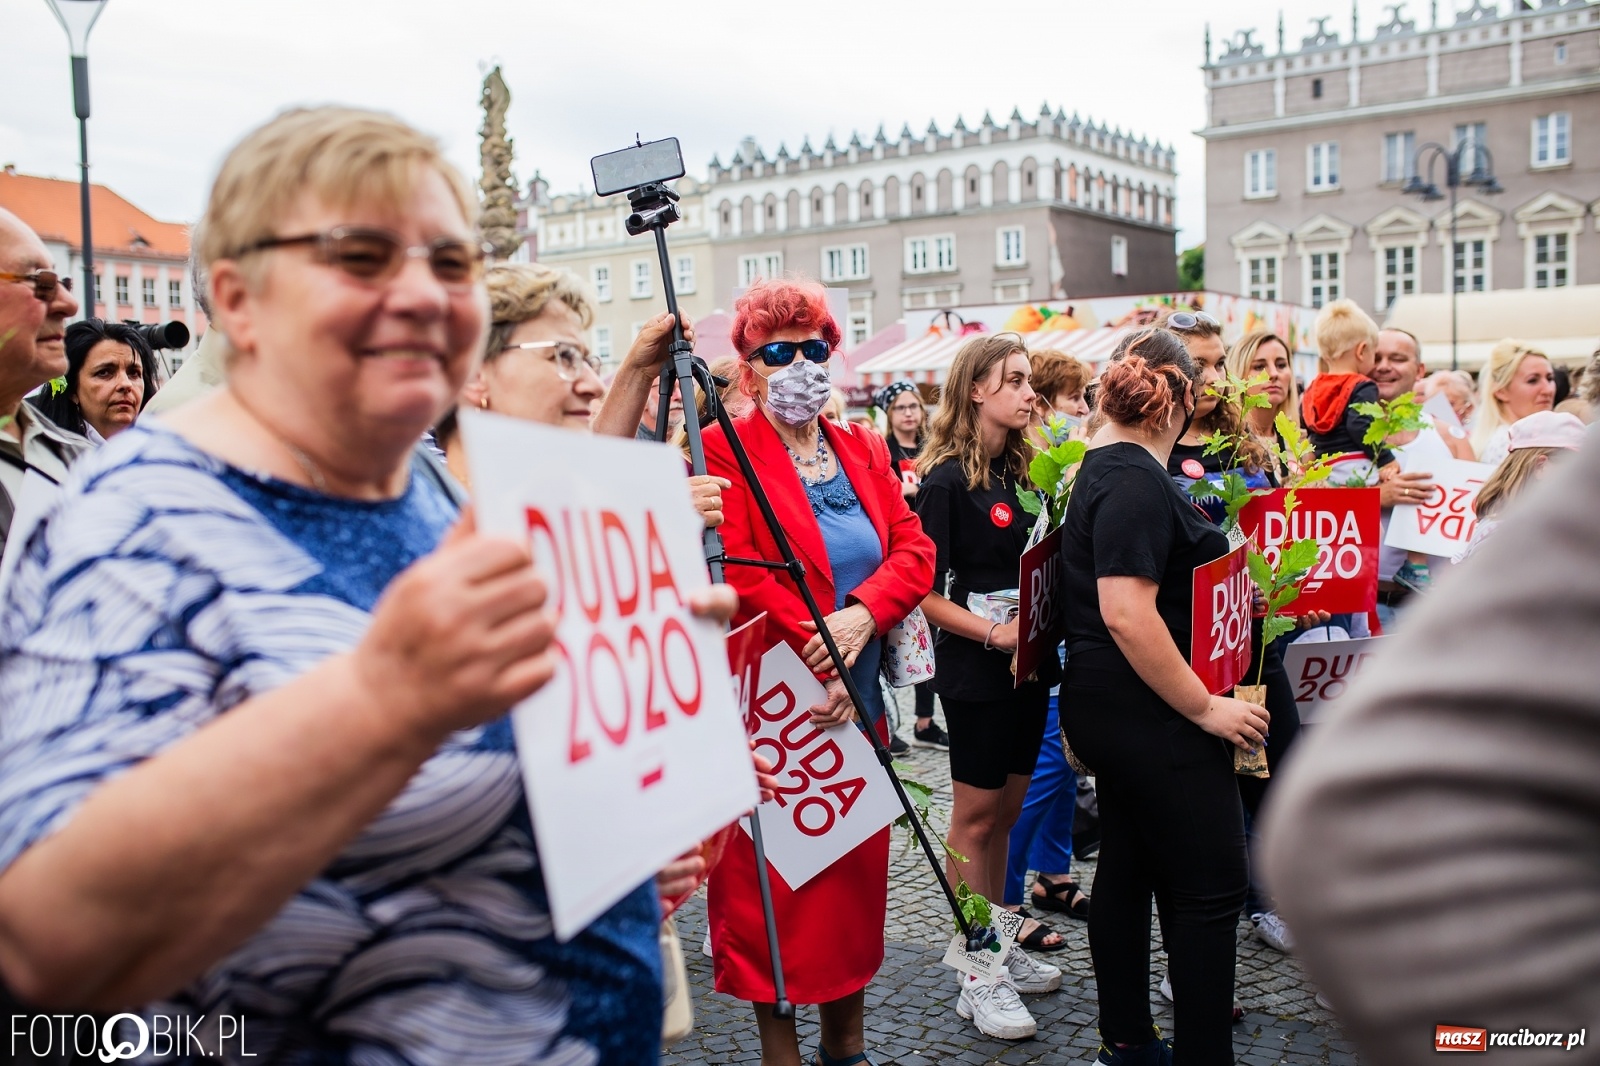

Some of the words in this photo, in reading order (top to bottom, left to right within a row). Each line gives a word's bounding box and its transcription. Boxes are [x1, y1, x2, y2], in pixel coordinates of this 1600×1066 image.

[1421, 484, 1478, 514] 20
[1264, 510, 1363, 545] DUDA
[525, 507, 689, 624] DUDA
[1031, 551, 1061, 607] DUD
[1262, 543, 1363, 581] 220
[553, 616, 703, 763] 2020
[1295, 679, 1349, 703] 20
[755, 680, 867, 819] DUDA
[751, 712, 836, 837] 020
[966, 953, 991, 968] POLSKIE
